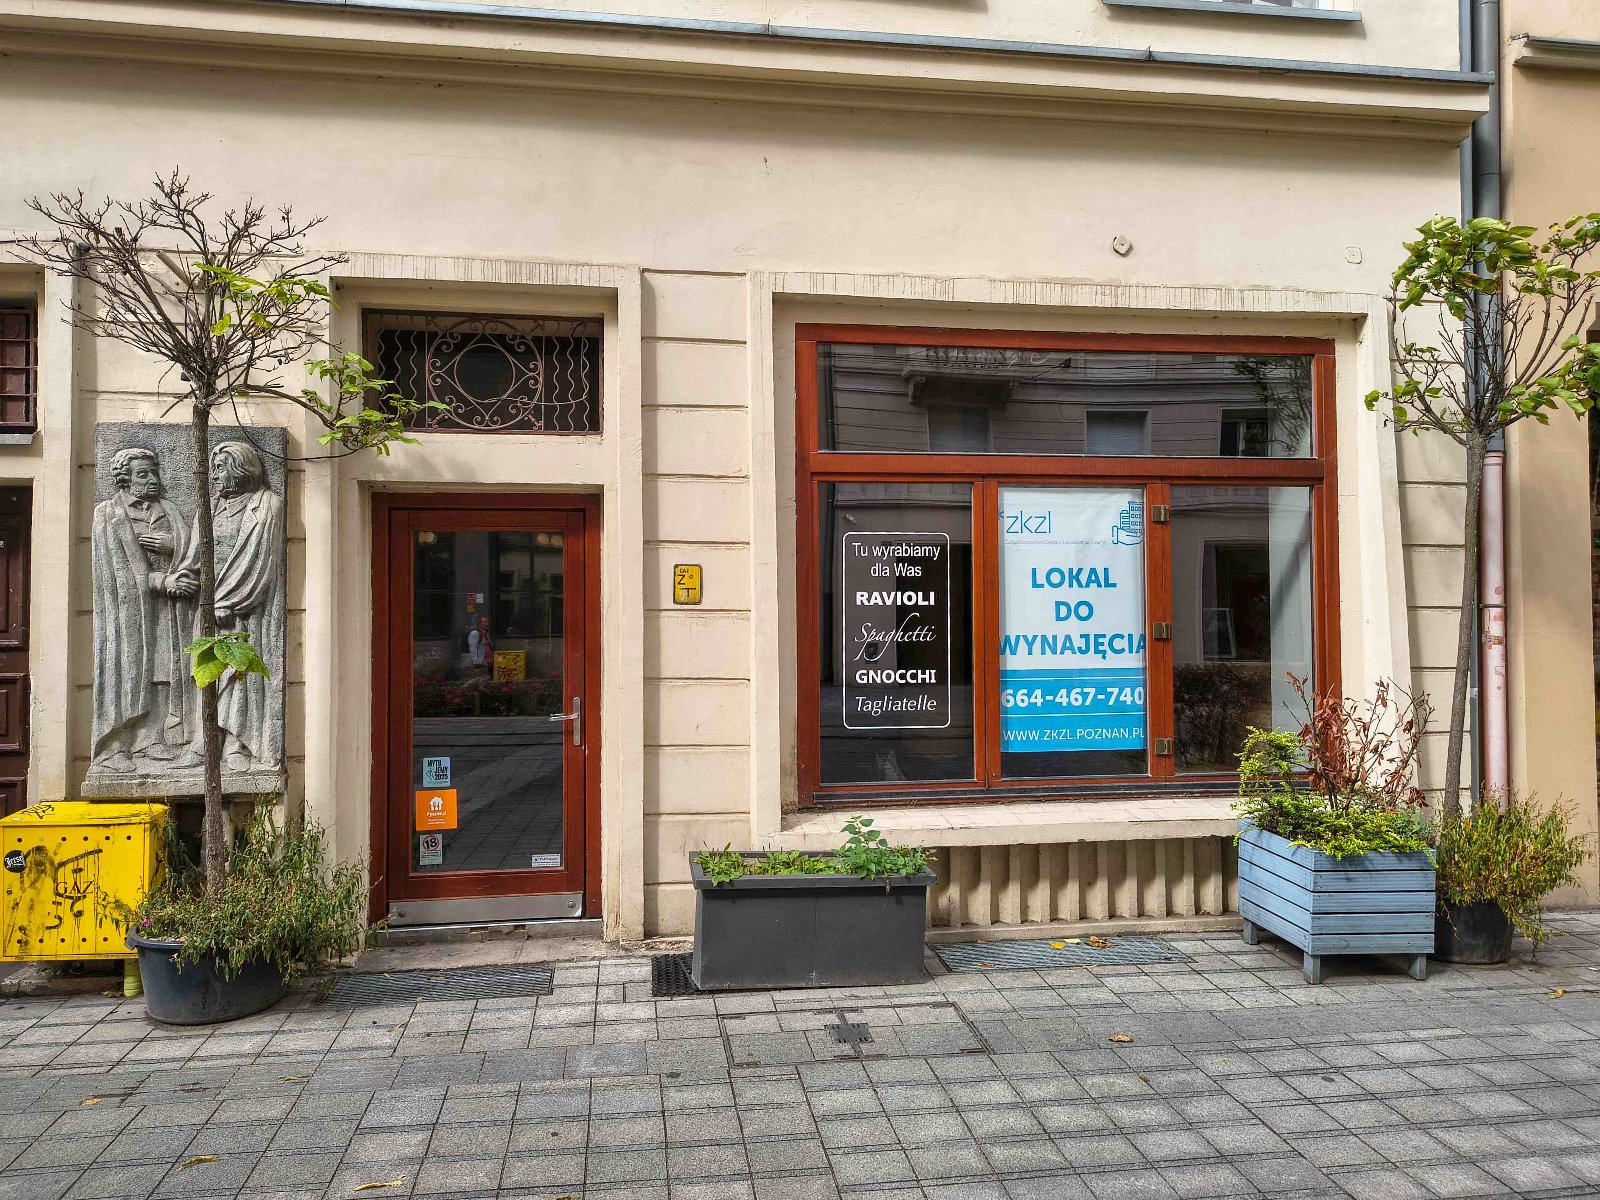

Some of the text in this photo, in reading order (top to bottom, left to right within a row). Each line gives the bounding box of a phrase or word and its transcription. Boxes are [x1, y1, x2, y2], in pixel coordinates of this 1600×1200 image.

[1006, 510, 1051, 534] zkzl
[852, 542, 941, 560] Tu wyrabiamy
[870, 562, 922, 577] dla Was
[1031, 567, 1117, 589] LOKAL
[856, 591, 935, 606] RAVIOLI
[1054, 600, 1094, 622] DO
[853, 612, 937, 662] Spaghetti
[855, 669, 937, 684] GNOCCHI
[855, 694, 937, 717] Tagliatelle
[1001, 687, 1145, 708] 664-467-740
[1003, 727, 1145, 742] WWW.ZKZL.POZNAN.PL
[424, 837, 437, 849] 18
[55, 881, 94, 894] GAZ
